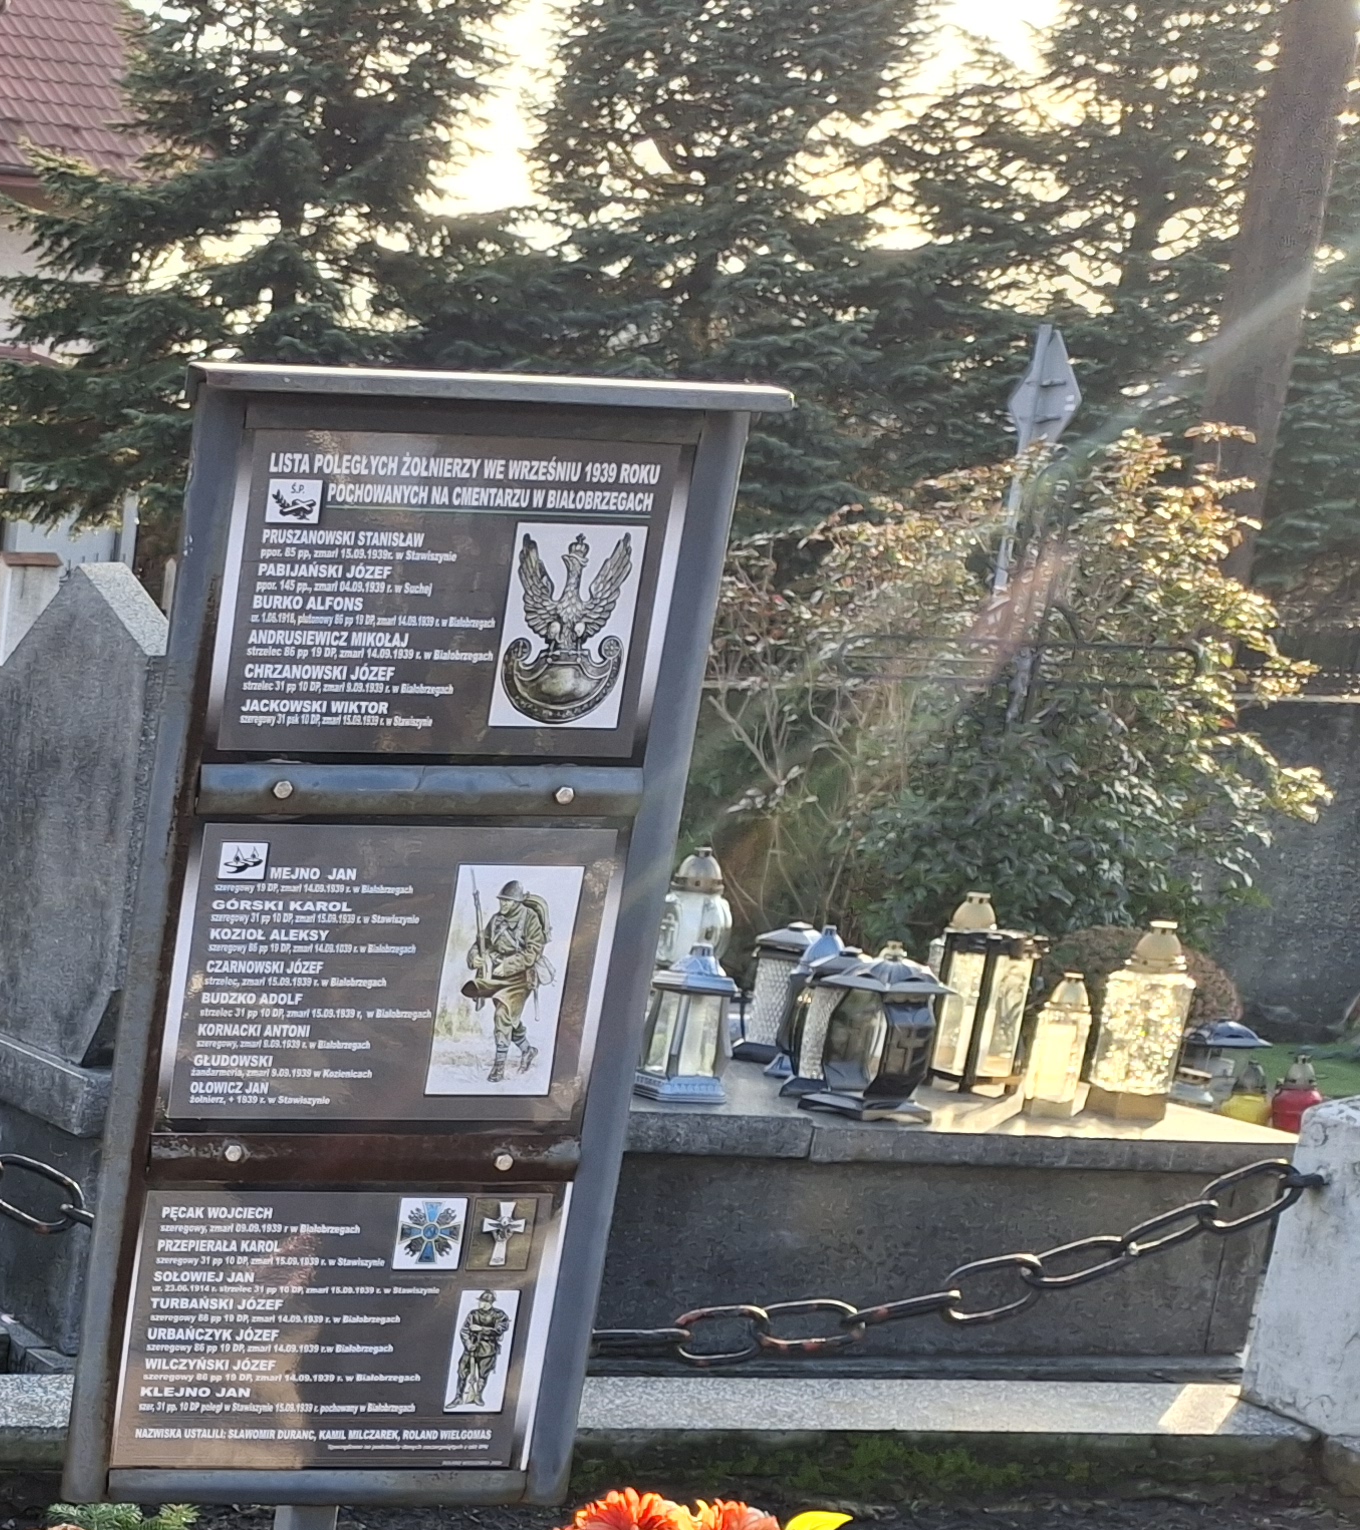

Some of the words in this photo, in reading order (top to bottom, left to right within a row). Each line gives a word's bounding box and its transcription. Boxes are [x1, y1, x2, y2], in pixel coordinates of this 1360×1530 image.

[269, 453, 310, 473] LISTA
[314, 454, 398, 476] POLEGŁYCH
[401, 452, 482, 478] ŻOŁNIERZY
[484, 460, 506, 479] WE
[509, 456, 582, 482] WRZEŚNIU
[585, 463, 617, 483] 1939
[619, 464, 661, 484] ROKU
[328, 483, 428, 504] POCHOWANYCH
[431, 486, 449, 505] NA
[453, 487, 530, 508] CMENTARZU
[533, 489, 545, 508] W
[547, 491, 654, 512] BIAŁOBRZEGACH
[262, 529, 355, 545] PRUSZANOWSKI
[358, 531, 425, 547] STANISŁAW
[258, 562, 342, 577] PABIJAŃSKI
[346, 563, 392, 579] JÓZEF
[253, 595, 303, 609] BURKO
[306, 596, 363, 611] ALFONS
[248, 630, 348, 646] ANDRUSIEWICZ
[351, 632, 409, 647] MIKOŁAJ
[244, 664, 347, 680] CHRZANOWSKI
[350, 663, 395, 681] JÓZEF
[241, 700, 327, 712] JACKOWSKI
[331, 701, 388, 714] WIKTOR
[270, 867, 320, 880] MEJNO
[328, 868, 356, 881] JAN
[212, 898, 283, 910] GÓRSKI
[289, 901, 352, 912] KAROL
[210, 928, 266, 940] KOZIOŁ
[270, 929, 329, 941] ALEKSY
[206, 961, 284, 973] CZARNOWSKI
[287, 959, 324, 974] JÓZEF
[201, 992, 256, 1004] BUDZKO
[260, 993, 302, 1005] ADOLF
[198, 1024, 261, 1036] KORNACKI
[264, 1024, 310, 1037] ANTONI
[193, 1055, 273, 1067] GŁUDOWSKI
[190, 1082, 242, 1093] OŁOWICZ
[244, 1082, 269, 1094] JAN
[162, 1207, 205, 1221] PĘCAK
[208, 1207, 273, 1218] WOJCIECH
[157, 1240, 237, 1252] PRZEPIERAŁA
[241, 1240, 281, 1252] KAROL
[153, 1271, 224, 1282] SOŁOWIEJ
[227, 1272, 254, 1282] JAN
[151, 1296, 233, 1310] TURBAŃSKI
[237, 1297, 284, 1310] JÓZEF
[148, 1326, 233, 1340] URBAŃCZYK
[236, 1327, 279, 1341] JÓZEF
[145, 1357, 229, 1370] WILCZYŃSKI
[233, 1357, 276, 1371] JÓZEF
[140, 1387, 210, 1397] KLEJNO
[215, 1387, 251, 1397] JAN
[135, 1428, 182, 1439] NAZWISKA
[403, 1430, 438, 1440] ROLAND
